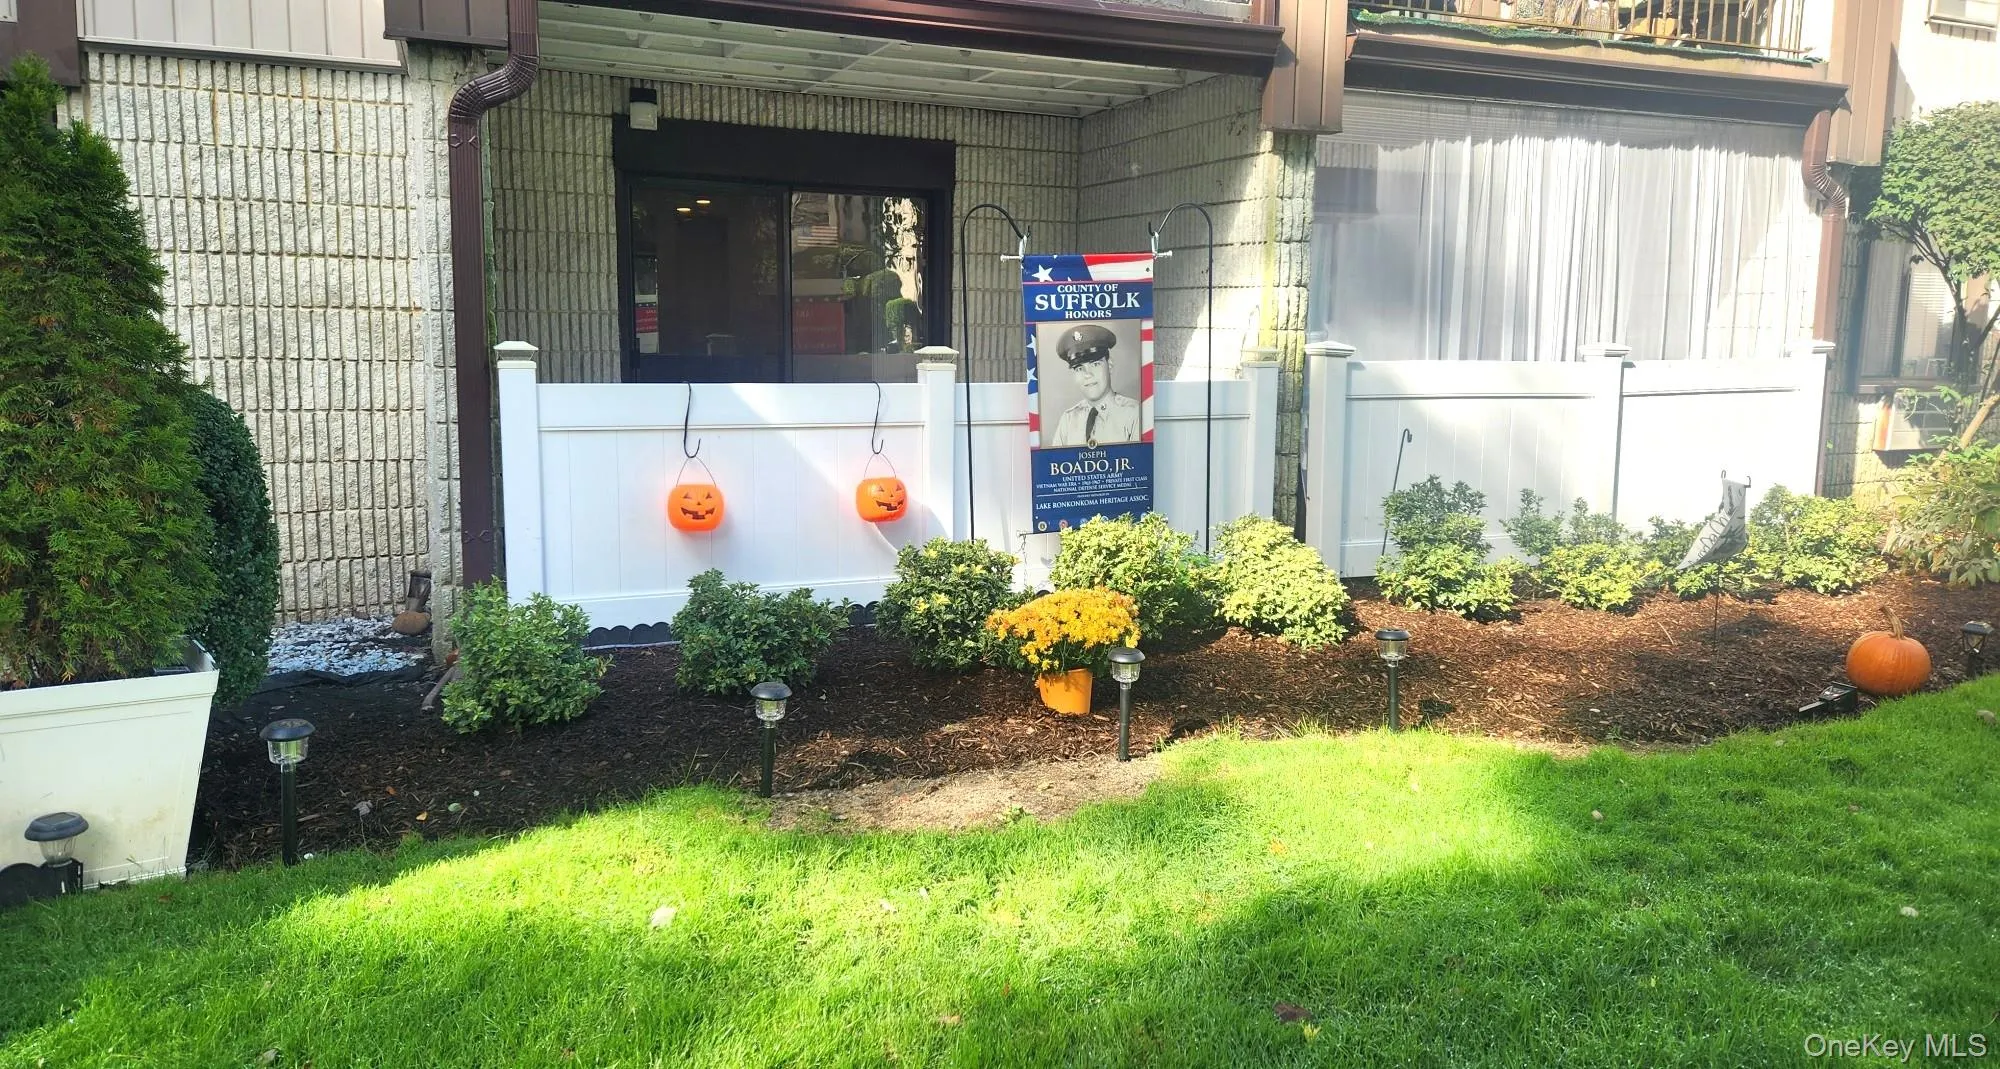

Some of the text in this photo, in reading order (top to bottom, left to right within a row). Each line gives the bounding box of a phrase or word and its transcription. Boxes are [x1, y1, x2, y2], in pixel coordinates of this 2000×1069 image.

[1057, 283, 1118, 293] COUNTY OF
[1035, 292, 1141, 311] SUFFOLK
[1065, 310, 1112, 319] HONORS
[1078, 451, 1107, 461] JOSEPH
[1050, 458, 1135, 476] BOADO, JR.
[1086, 473, 1106, 481] STATES
[1036, 502, 1051, 510] LAKE
[1099, 496, 1129, 505] HERITAGE
[1129, 494, 1149, 503] ASSOC.
